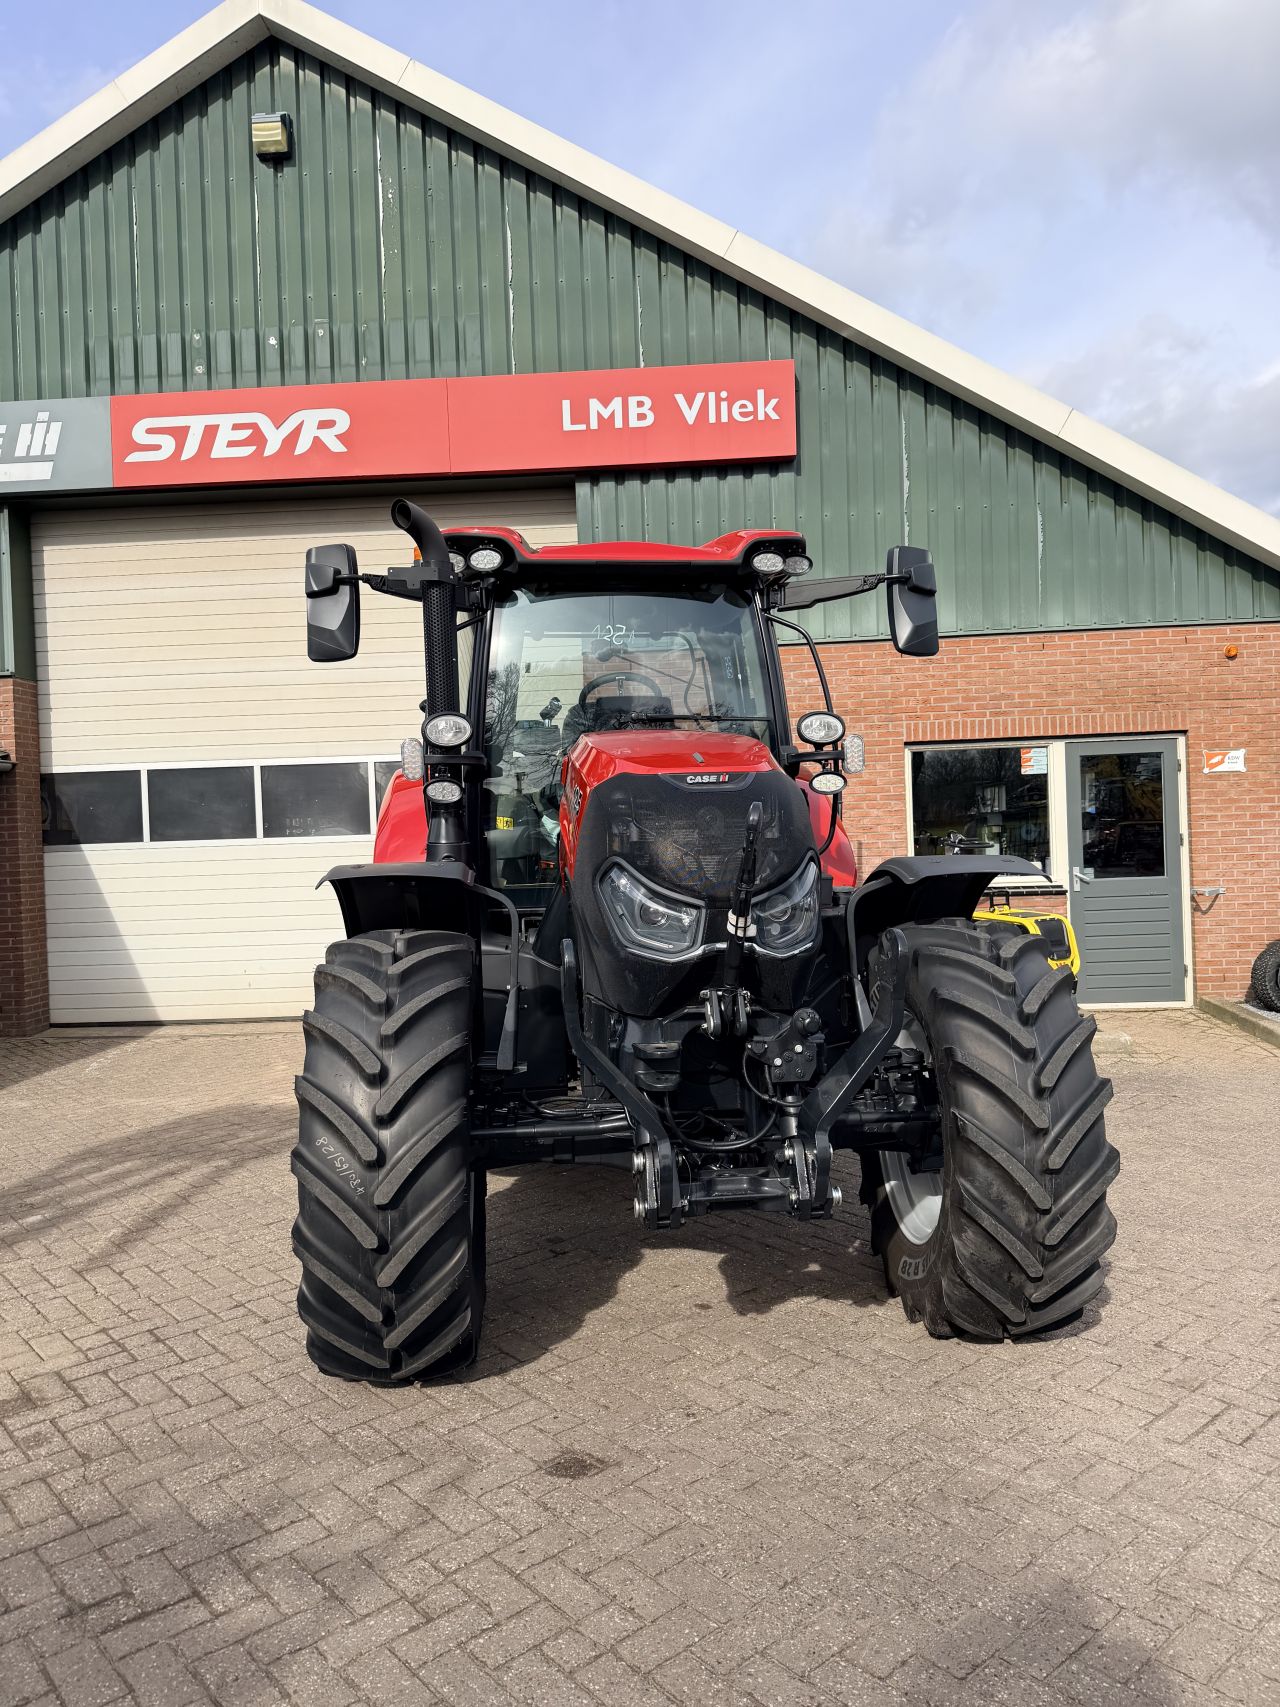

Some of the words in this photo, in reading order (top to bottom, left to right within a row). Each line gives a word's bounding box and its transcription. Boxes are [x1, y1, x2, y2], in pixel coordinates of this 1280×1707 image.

[562, 395, 655, 431] LMB
[674, 389, 780, 425] Vliek
[124, 408, 351, 463] STEYR
[686, 775, 718, 784] CASE
